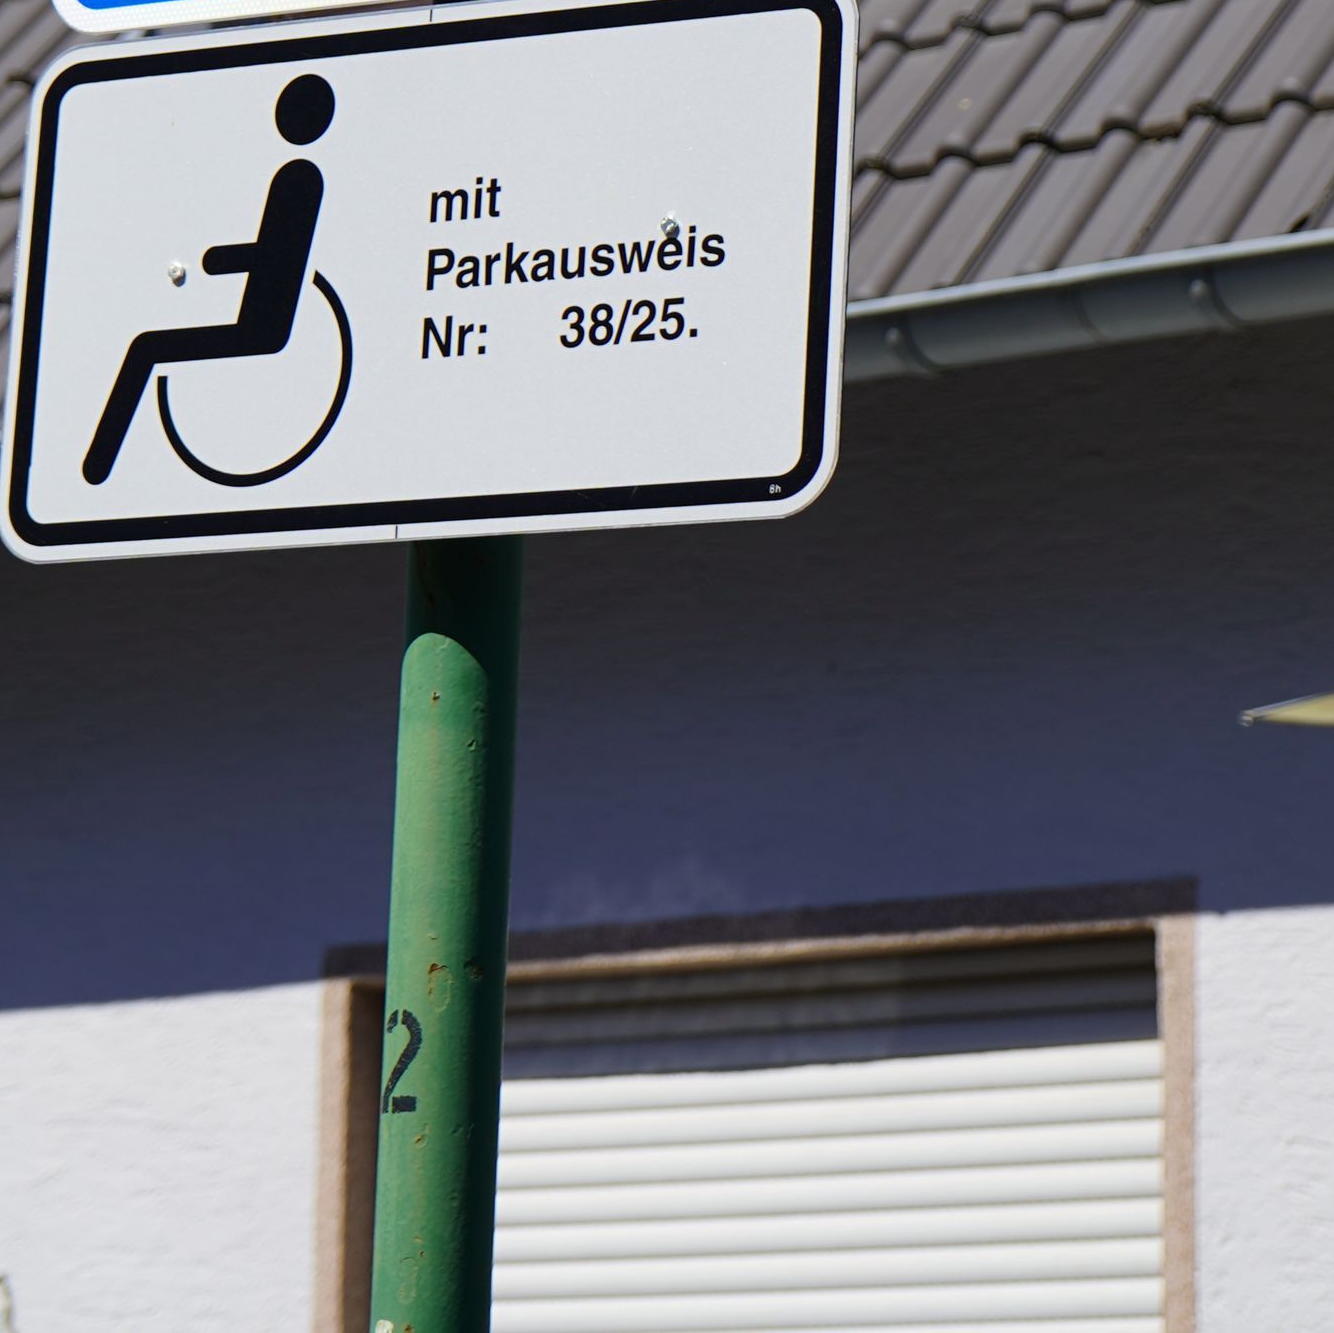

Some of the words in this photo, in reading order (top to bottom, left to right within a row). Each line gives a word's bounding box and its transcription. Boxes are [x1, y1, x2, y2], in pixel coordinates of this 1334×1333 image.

[429, 176, 502, 223] mit
[426, 224, 727, 291] Parkausweis
[421, 315, 487, 359] Nr:
[559, 297, 699, 348] 38/25.
[381, 1008, 423, 1114] 2
